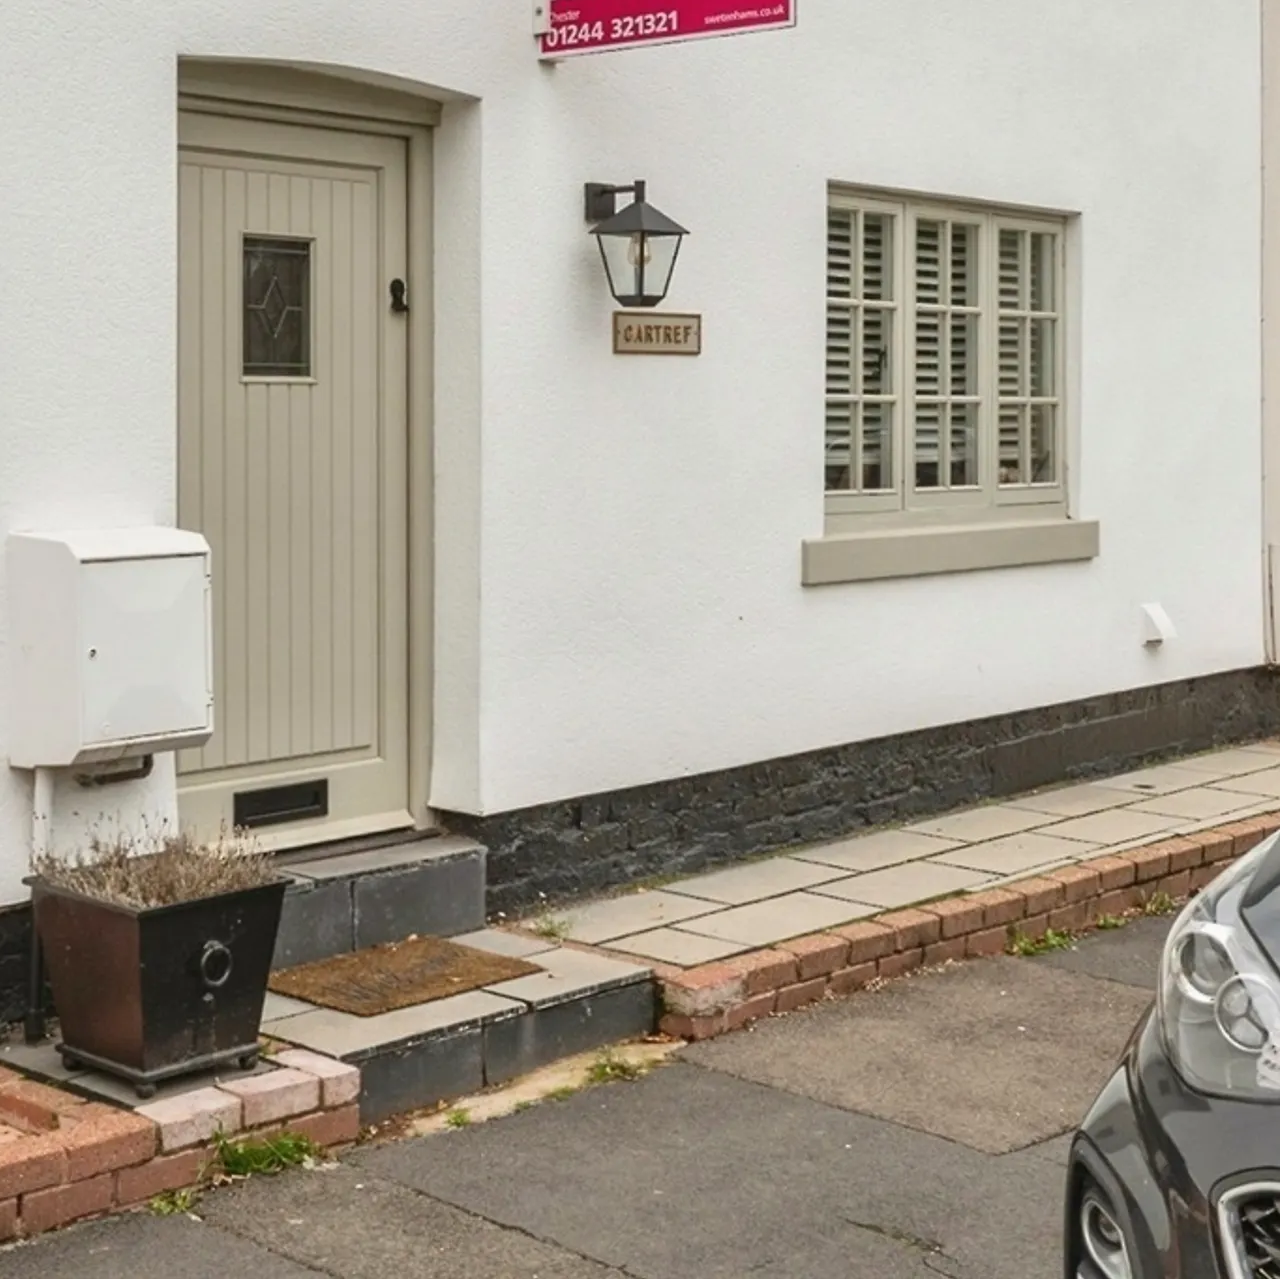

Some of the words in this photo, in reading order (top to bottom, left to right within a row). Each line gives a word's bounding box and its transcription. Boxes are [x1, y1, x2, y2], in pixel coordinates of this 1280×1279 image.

[704, 4, 785, 24] swetenhams.co.uk
[546, 21, 604, 47] 01244
[610, 10, 678, 39] 321321
[623, 324, 692, 344] CARTREF
